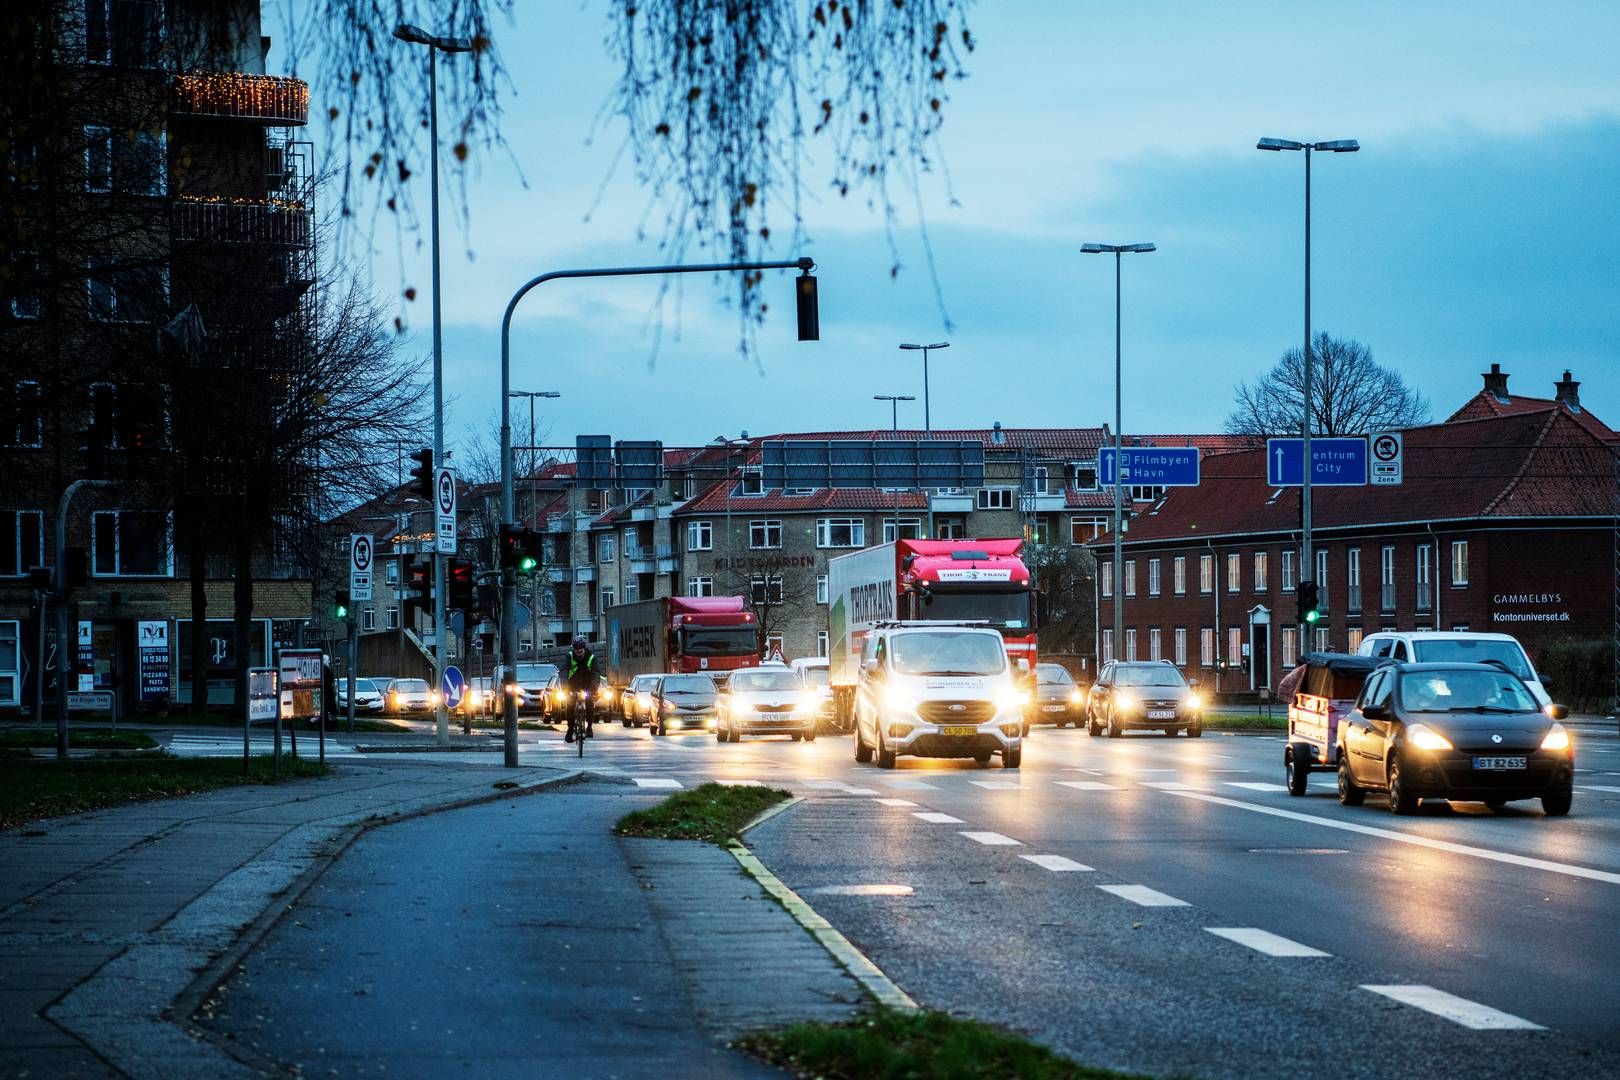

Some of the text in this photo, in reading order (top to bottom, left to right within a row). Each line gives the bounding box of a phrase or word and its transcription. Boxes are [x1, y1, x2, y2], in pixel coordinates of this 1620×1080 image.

[1311, 451, 1355, 460] entrum
[1134, 455, 1189, 467] Filmbyen
[1134, 468, 1164, 478] Havn
[1316, 463, 1342, 474] City
[1377, 476, 1395, 484] Zone
[441, 540, 452, 550] Zone
[850, 579, 893, 625] THORTRANS
[1493, 593, 1562, 604] GAMMELBYS
[1493, 611, 1570, 622] Kontoruniverset.dk
[1480, 758, 1527, 768] BT 82 635
